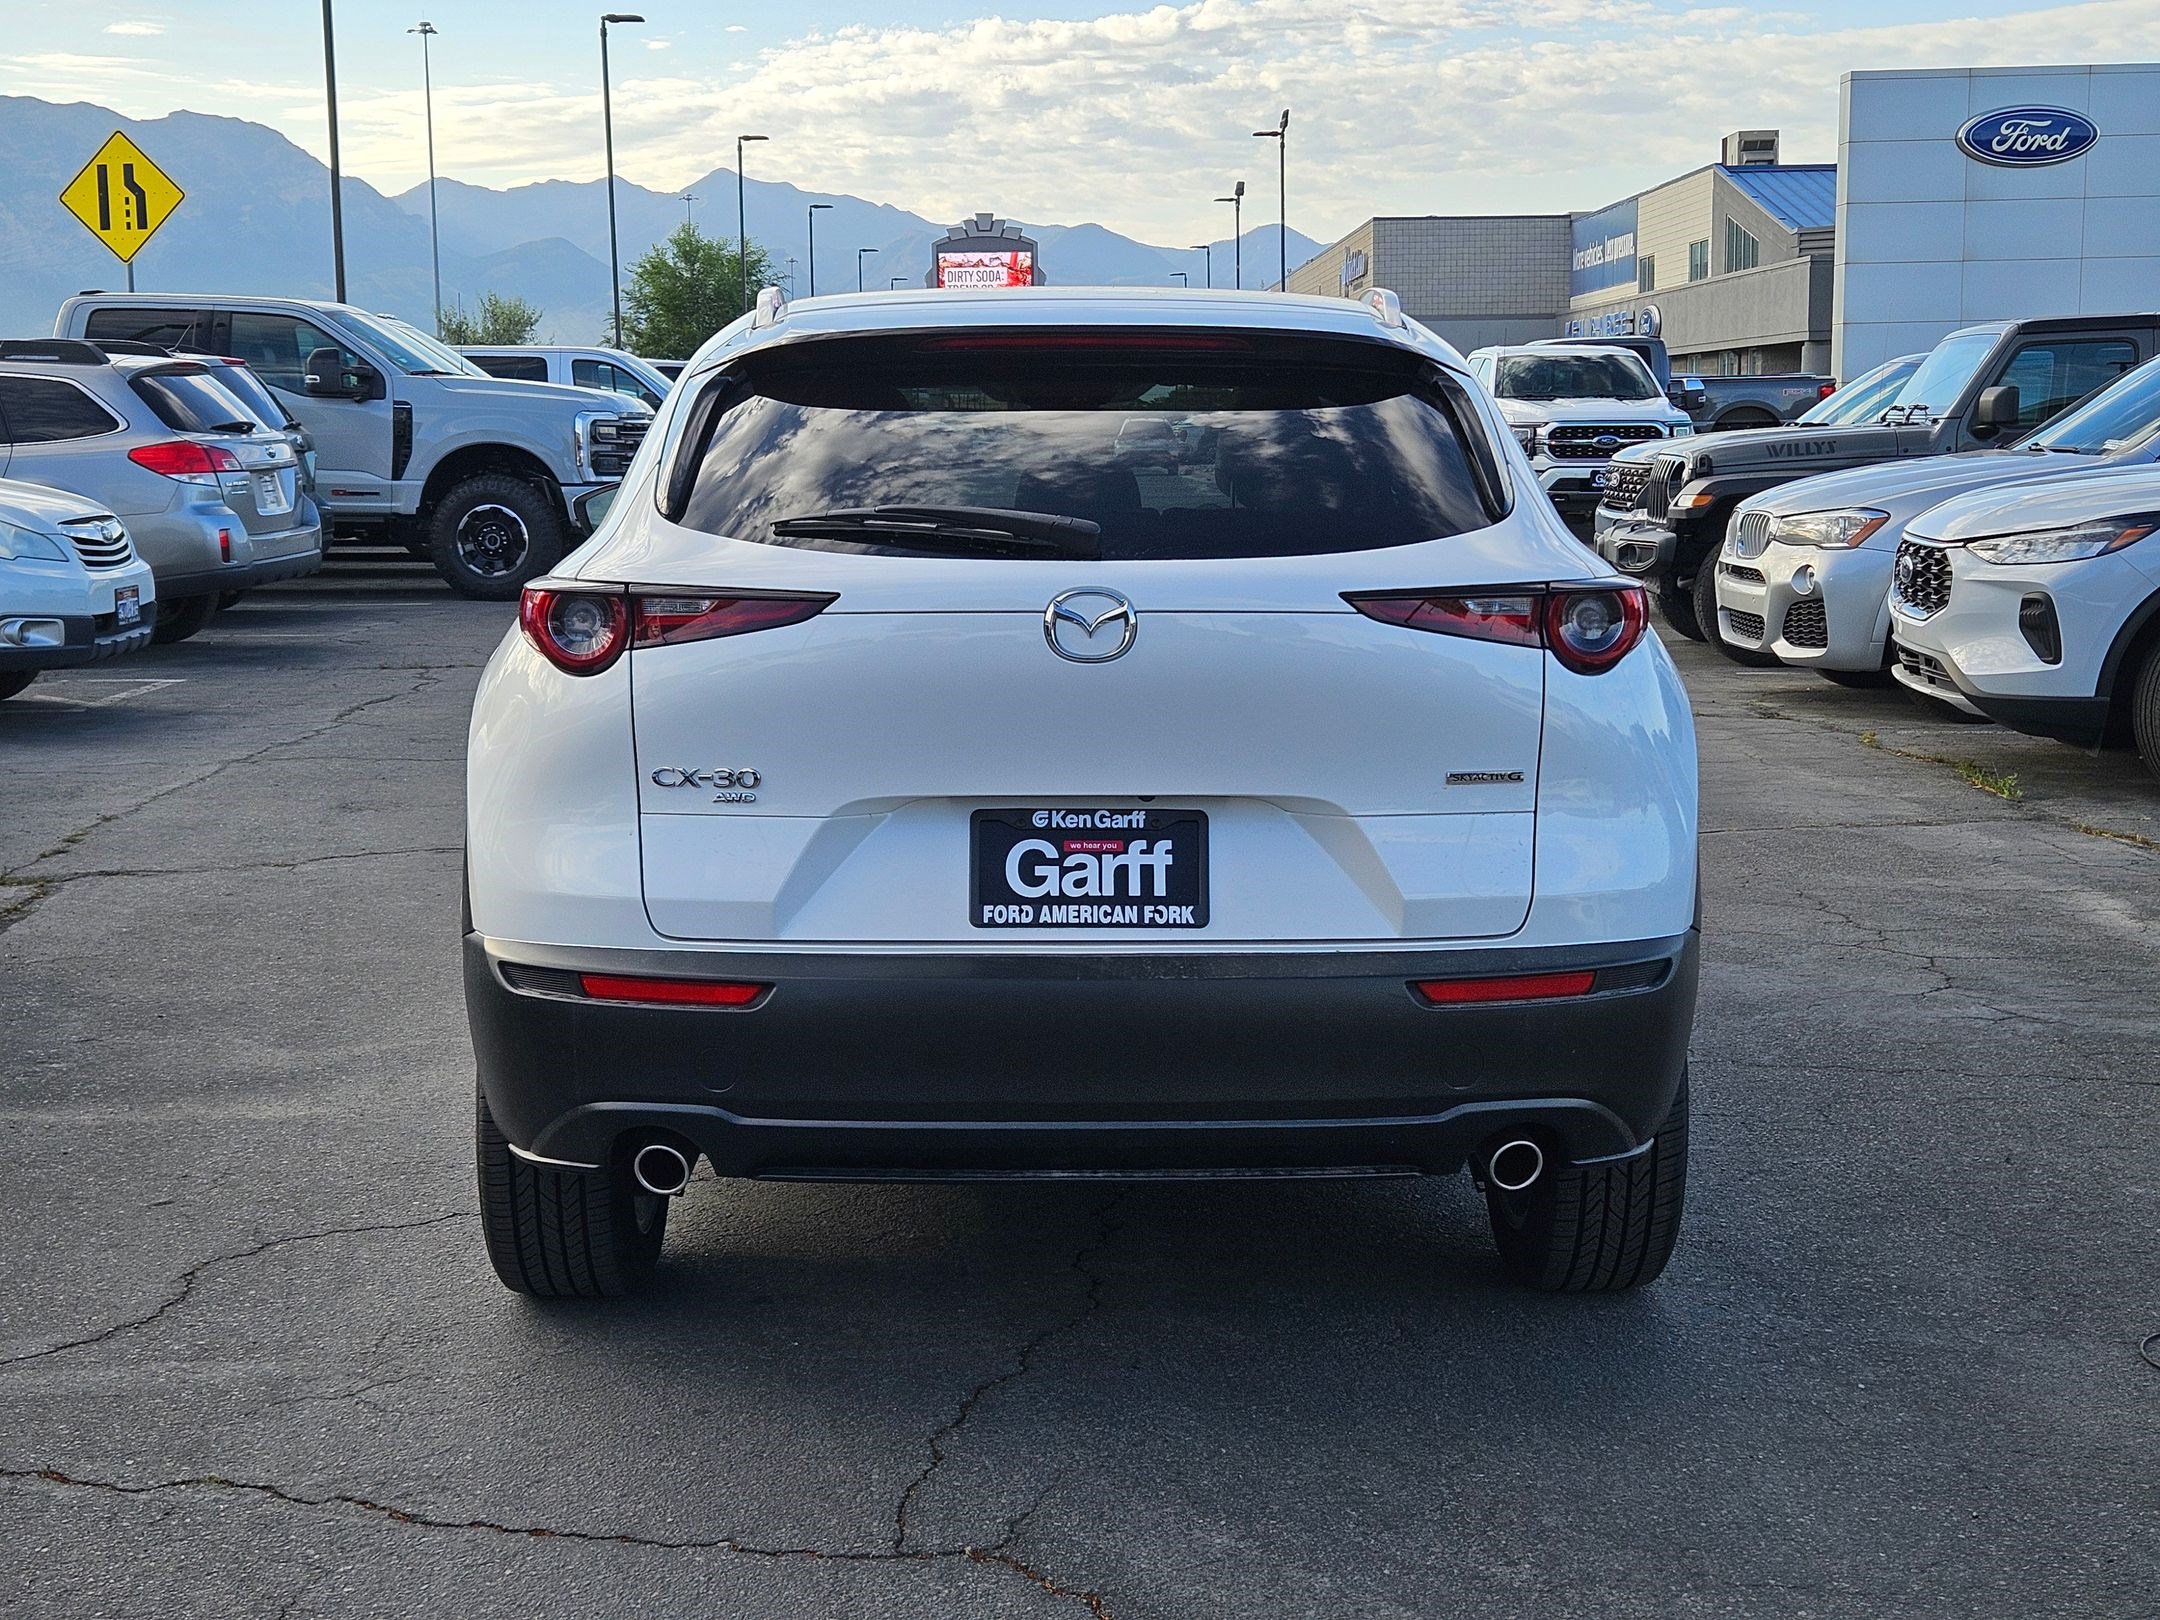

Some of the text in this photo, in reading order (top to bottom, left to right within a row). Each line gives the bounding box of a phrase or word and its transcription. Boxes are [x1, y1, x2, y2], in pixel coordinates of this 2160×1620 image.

[1991, 119, 2072, 152] Ford
[947, 270, 1005, 283] DIRTY SODA:
[1766, 440, 1837, 458] WILLYS
[652, 766, 762, 789] CX-30
[712, 792, 756, 803] AWD
[1051, 810, 1146, 829] Ken Garff
[1083, 841, 1101, 849] hear
[1102, 842, 1118, 851] you
[1005, 838, 1173, 898] Garff
[983, 905, 1195, 924] FORD AMERICAN FORK
